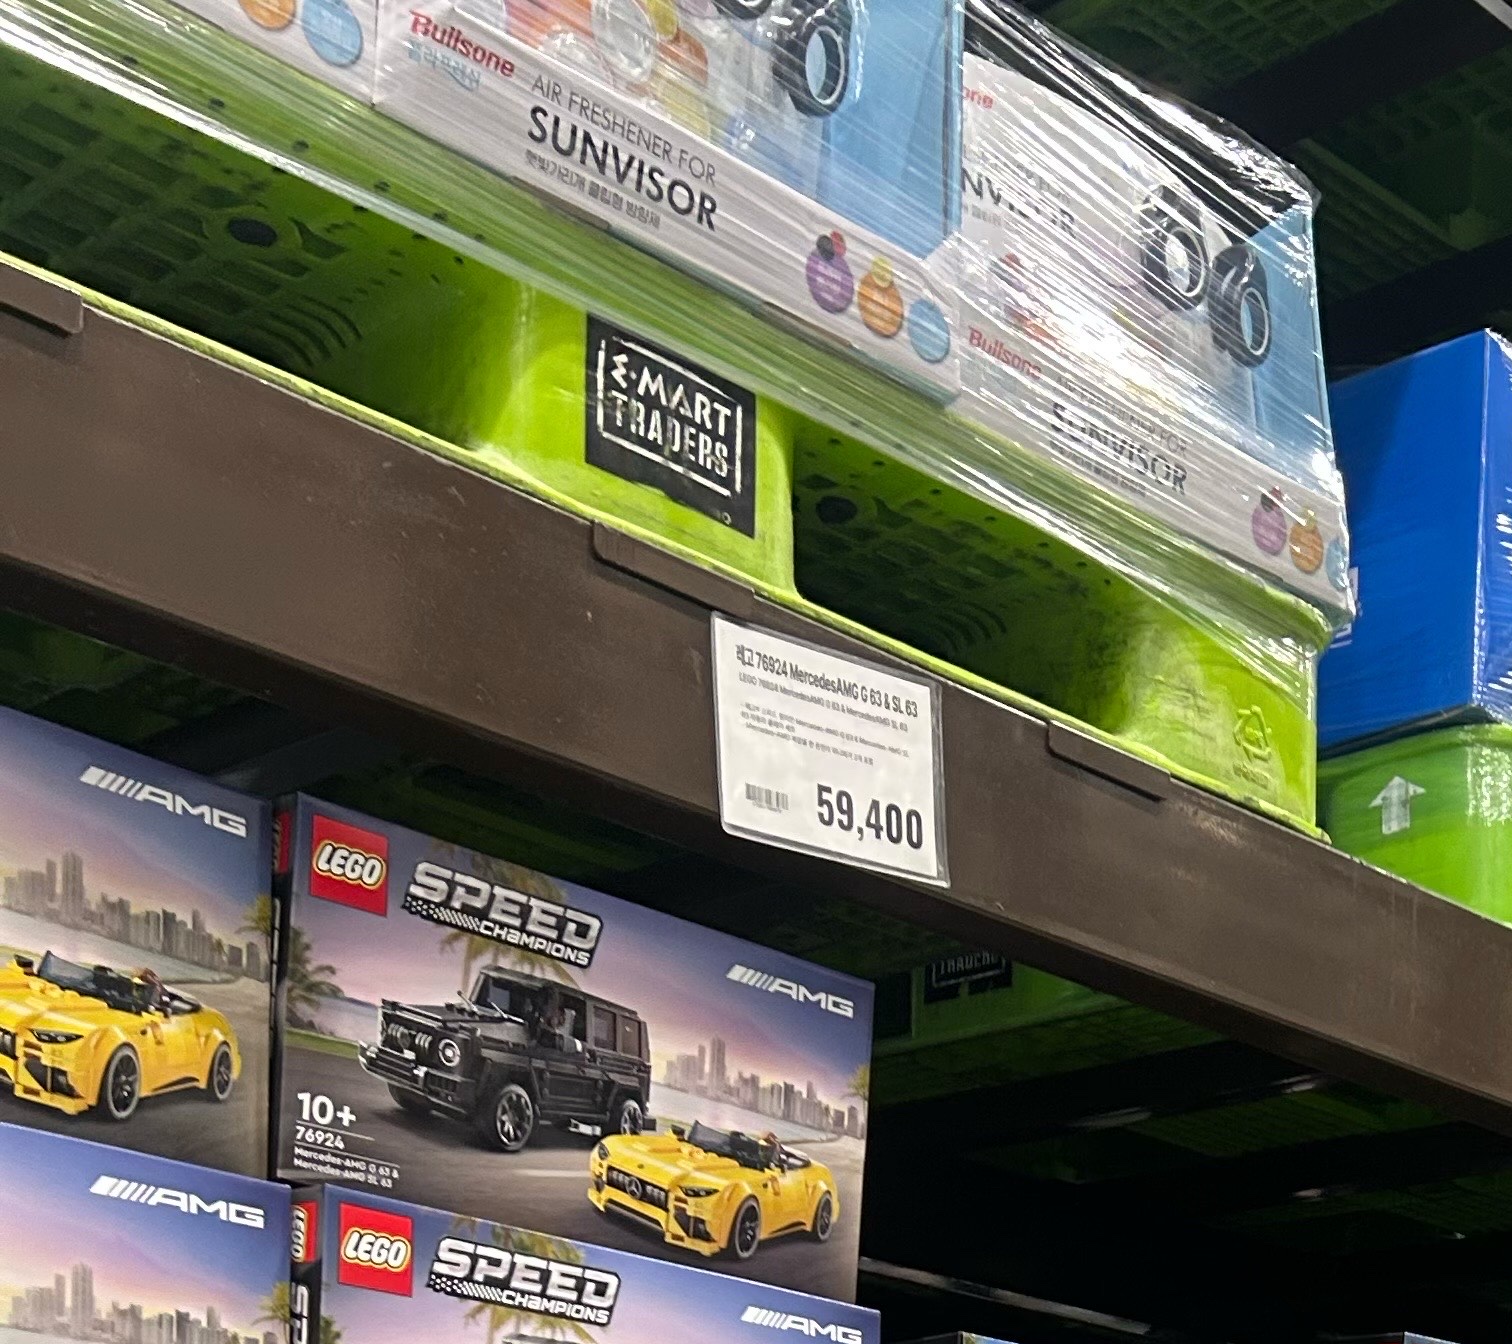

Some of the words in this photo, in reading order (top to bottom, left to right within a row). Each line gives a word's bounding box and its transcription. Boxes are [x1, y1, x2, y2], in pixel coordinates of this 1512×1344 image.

[410, 9, 515, 78] Bullsone
[531, 74, 563, 107] AIR
[568, 91, 673, 162] FRESHENER
[678, 151, 716, 188] FOR
[528, 105, 717, 231] SUNVISOR
[611, 390, 728, 477] TRADERS
[756, 651, 788, 679] 76924
[869, 689, 882, 709] 63
[905, 700, 918, 719] 63
[135, 785, 248, 838] AMG
[817, 783, 923, 850] 59,400
[316, 843, 383, 887] LEGO
[409, 861, 602, 951] SPEED
[770, 980, 854, 1019] AMG
[295, 1126, 345, 1150] 76924
[297, 1092, 357, 1128] 10+
[149, 1187, 265, 1230] AMG
[344, 1231, 408, 1269] LEGO
[431, 1238, 620, 1309] SPEED
